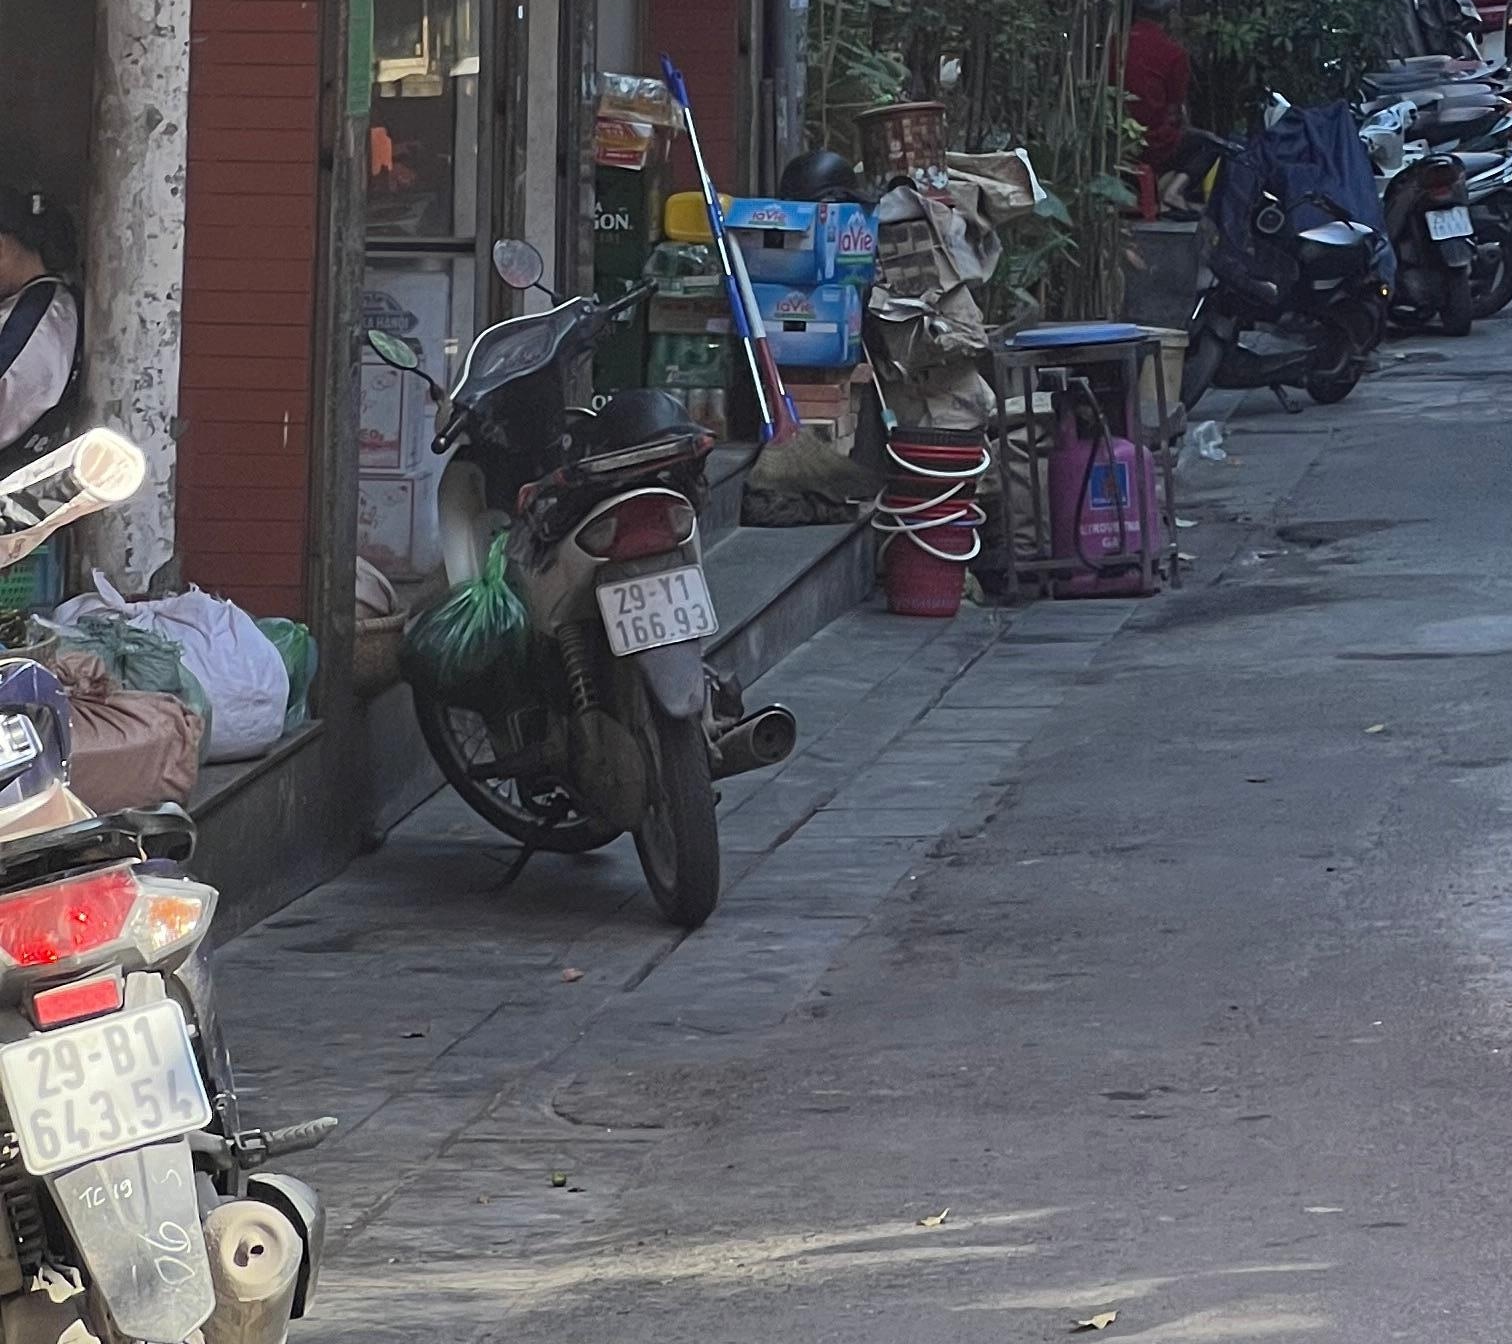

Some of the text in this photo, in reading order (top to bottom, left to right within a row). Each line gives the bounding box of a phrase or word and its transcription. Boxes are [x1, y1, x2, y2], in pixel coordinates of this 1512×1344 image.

[613, 574, 690, 615] 29-Y1
[615, 603, 709, 649] 166.93
[28, 1016, 161, 1099] 29-B1
[29, 1069, 193, 1160] 643.54
